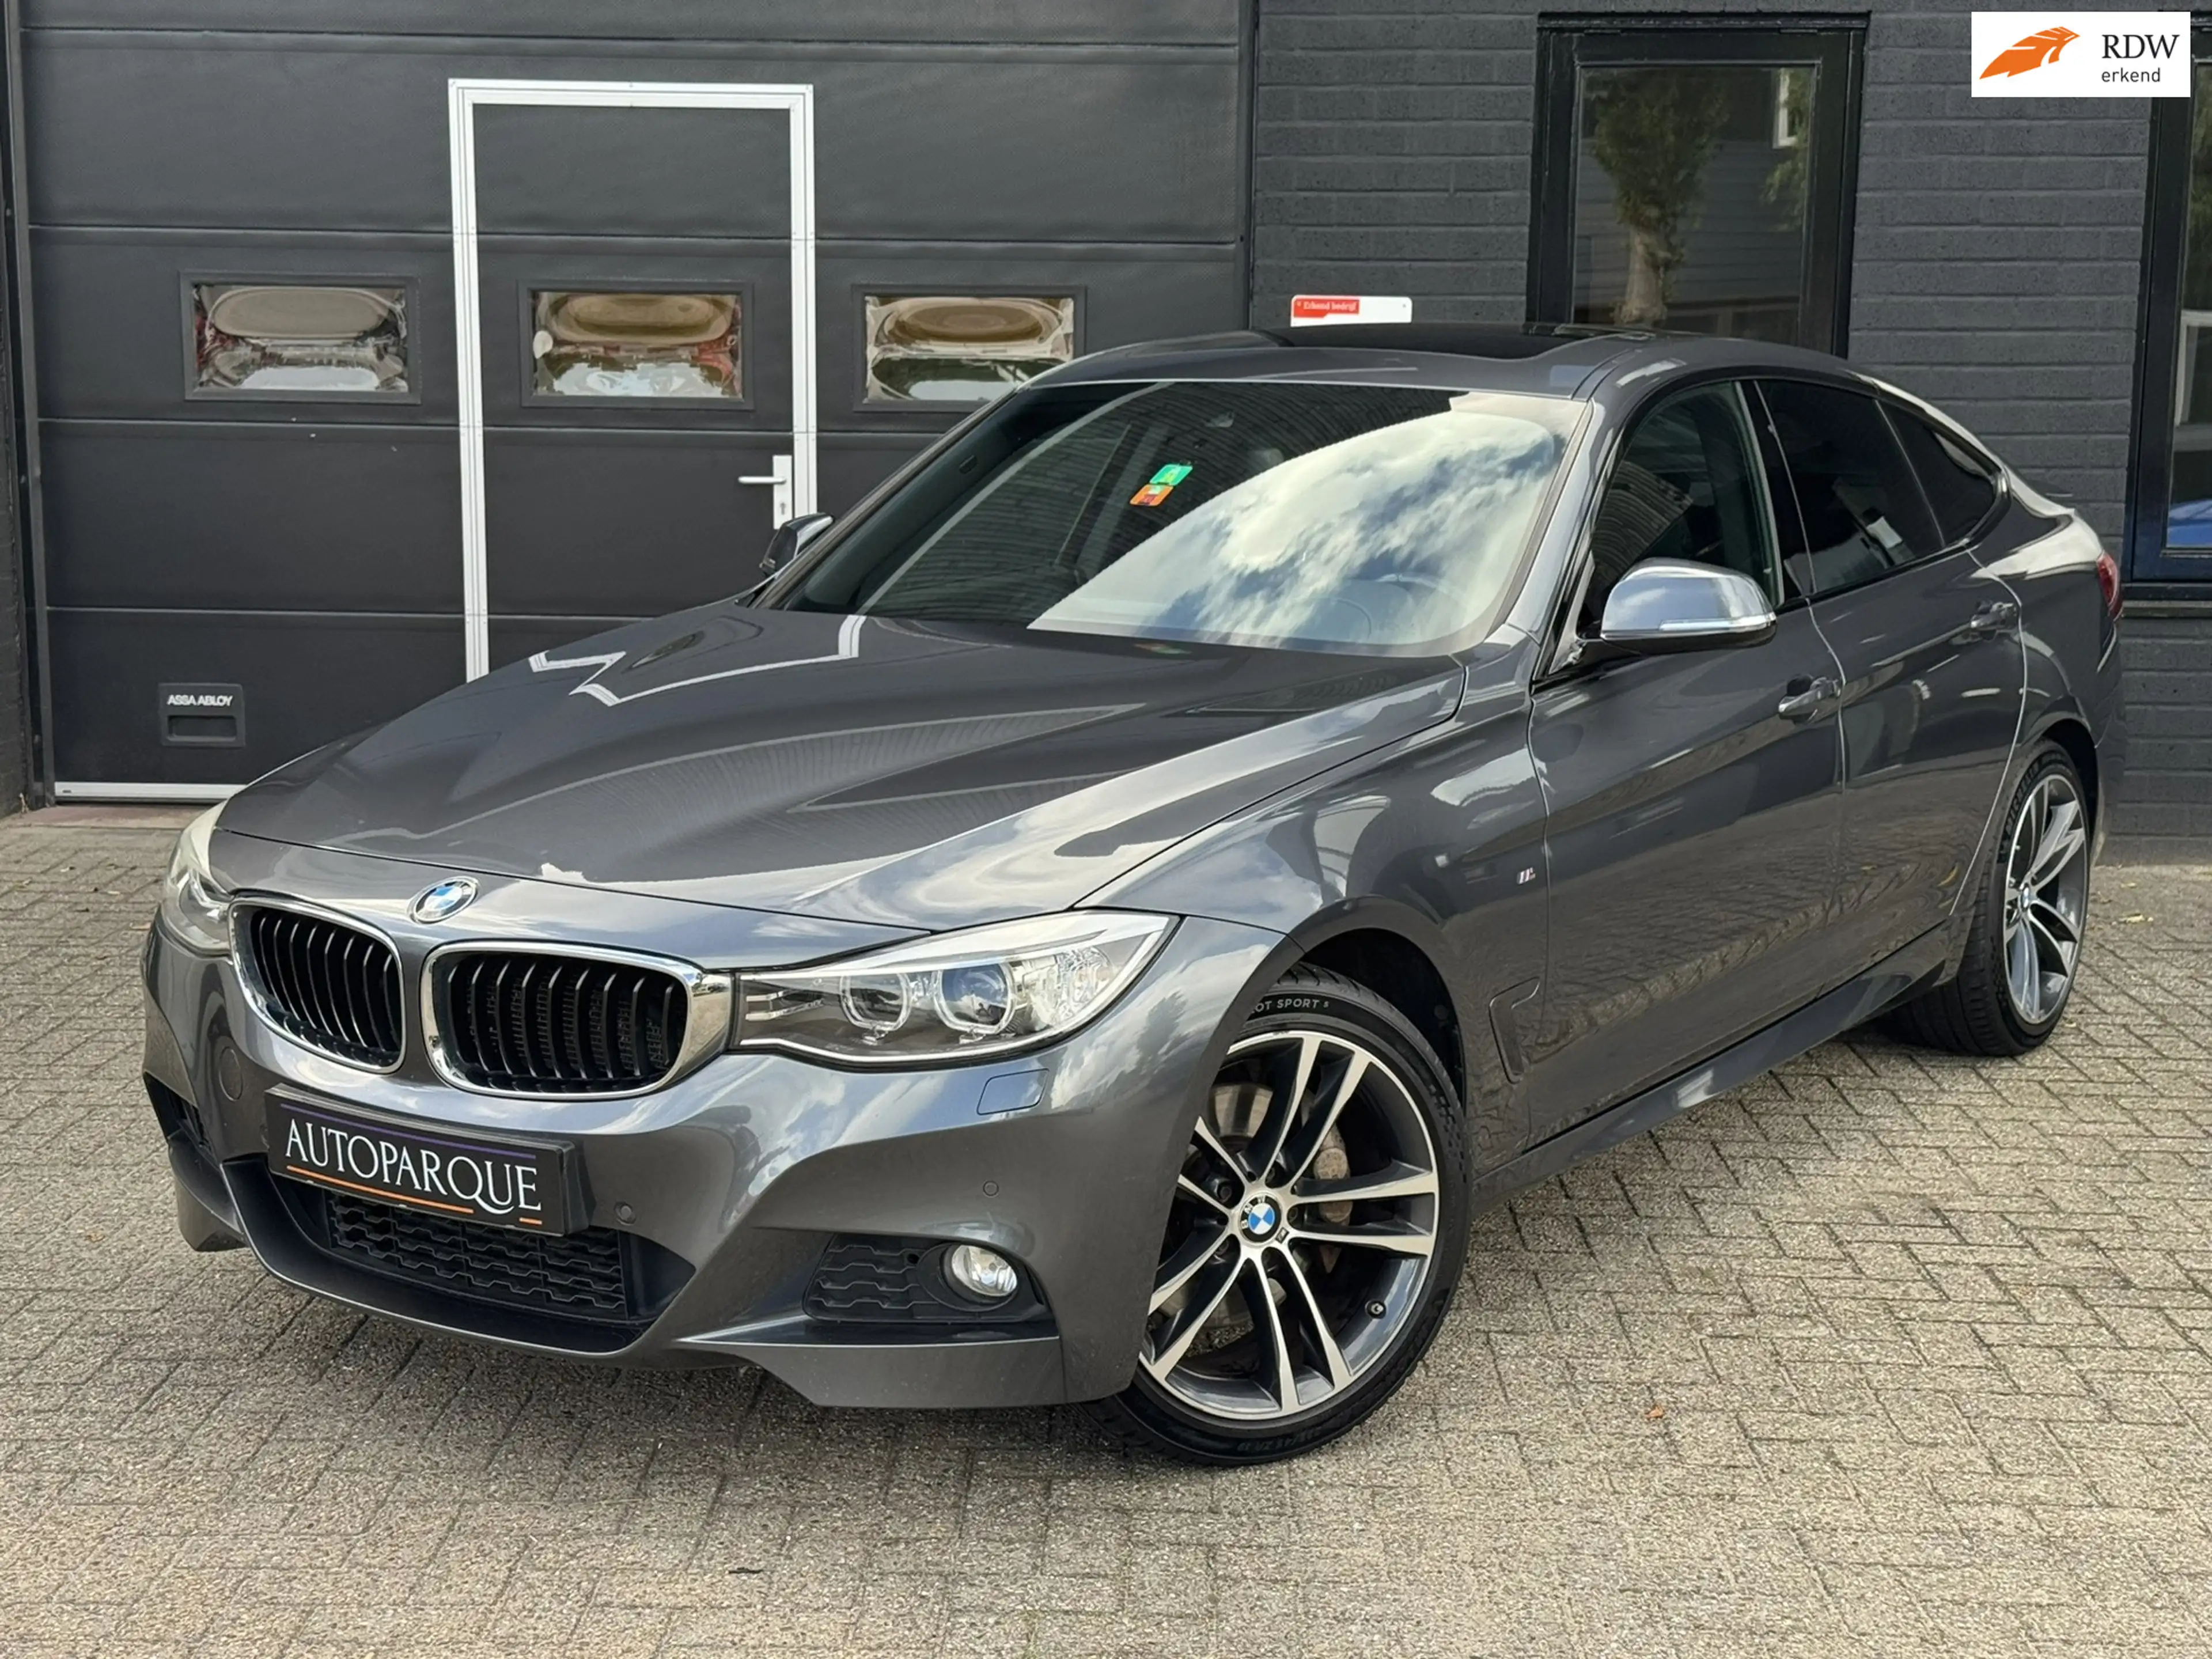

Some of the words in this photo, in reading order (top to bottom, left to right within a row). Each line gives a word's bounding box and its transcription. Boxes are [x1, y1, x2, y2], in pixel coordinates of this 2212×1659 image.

[166, 694, 196, 706] ASSA
[197, 695, 233, 706] ABLOY
[1277, 998, 1320, 1009] SPORT
[285, 1118, 541, 1214] AUTOPARQUE
